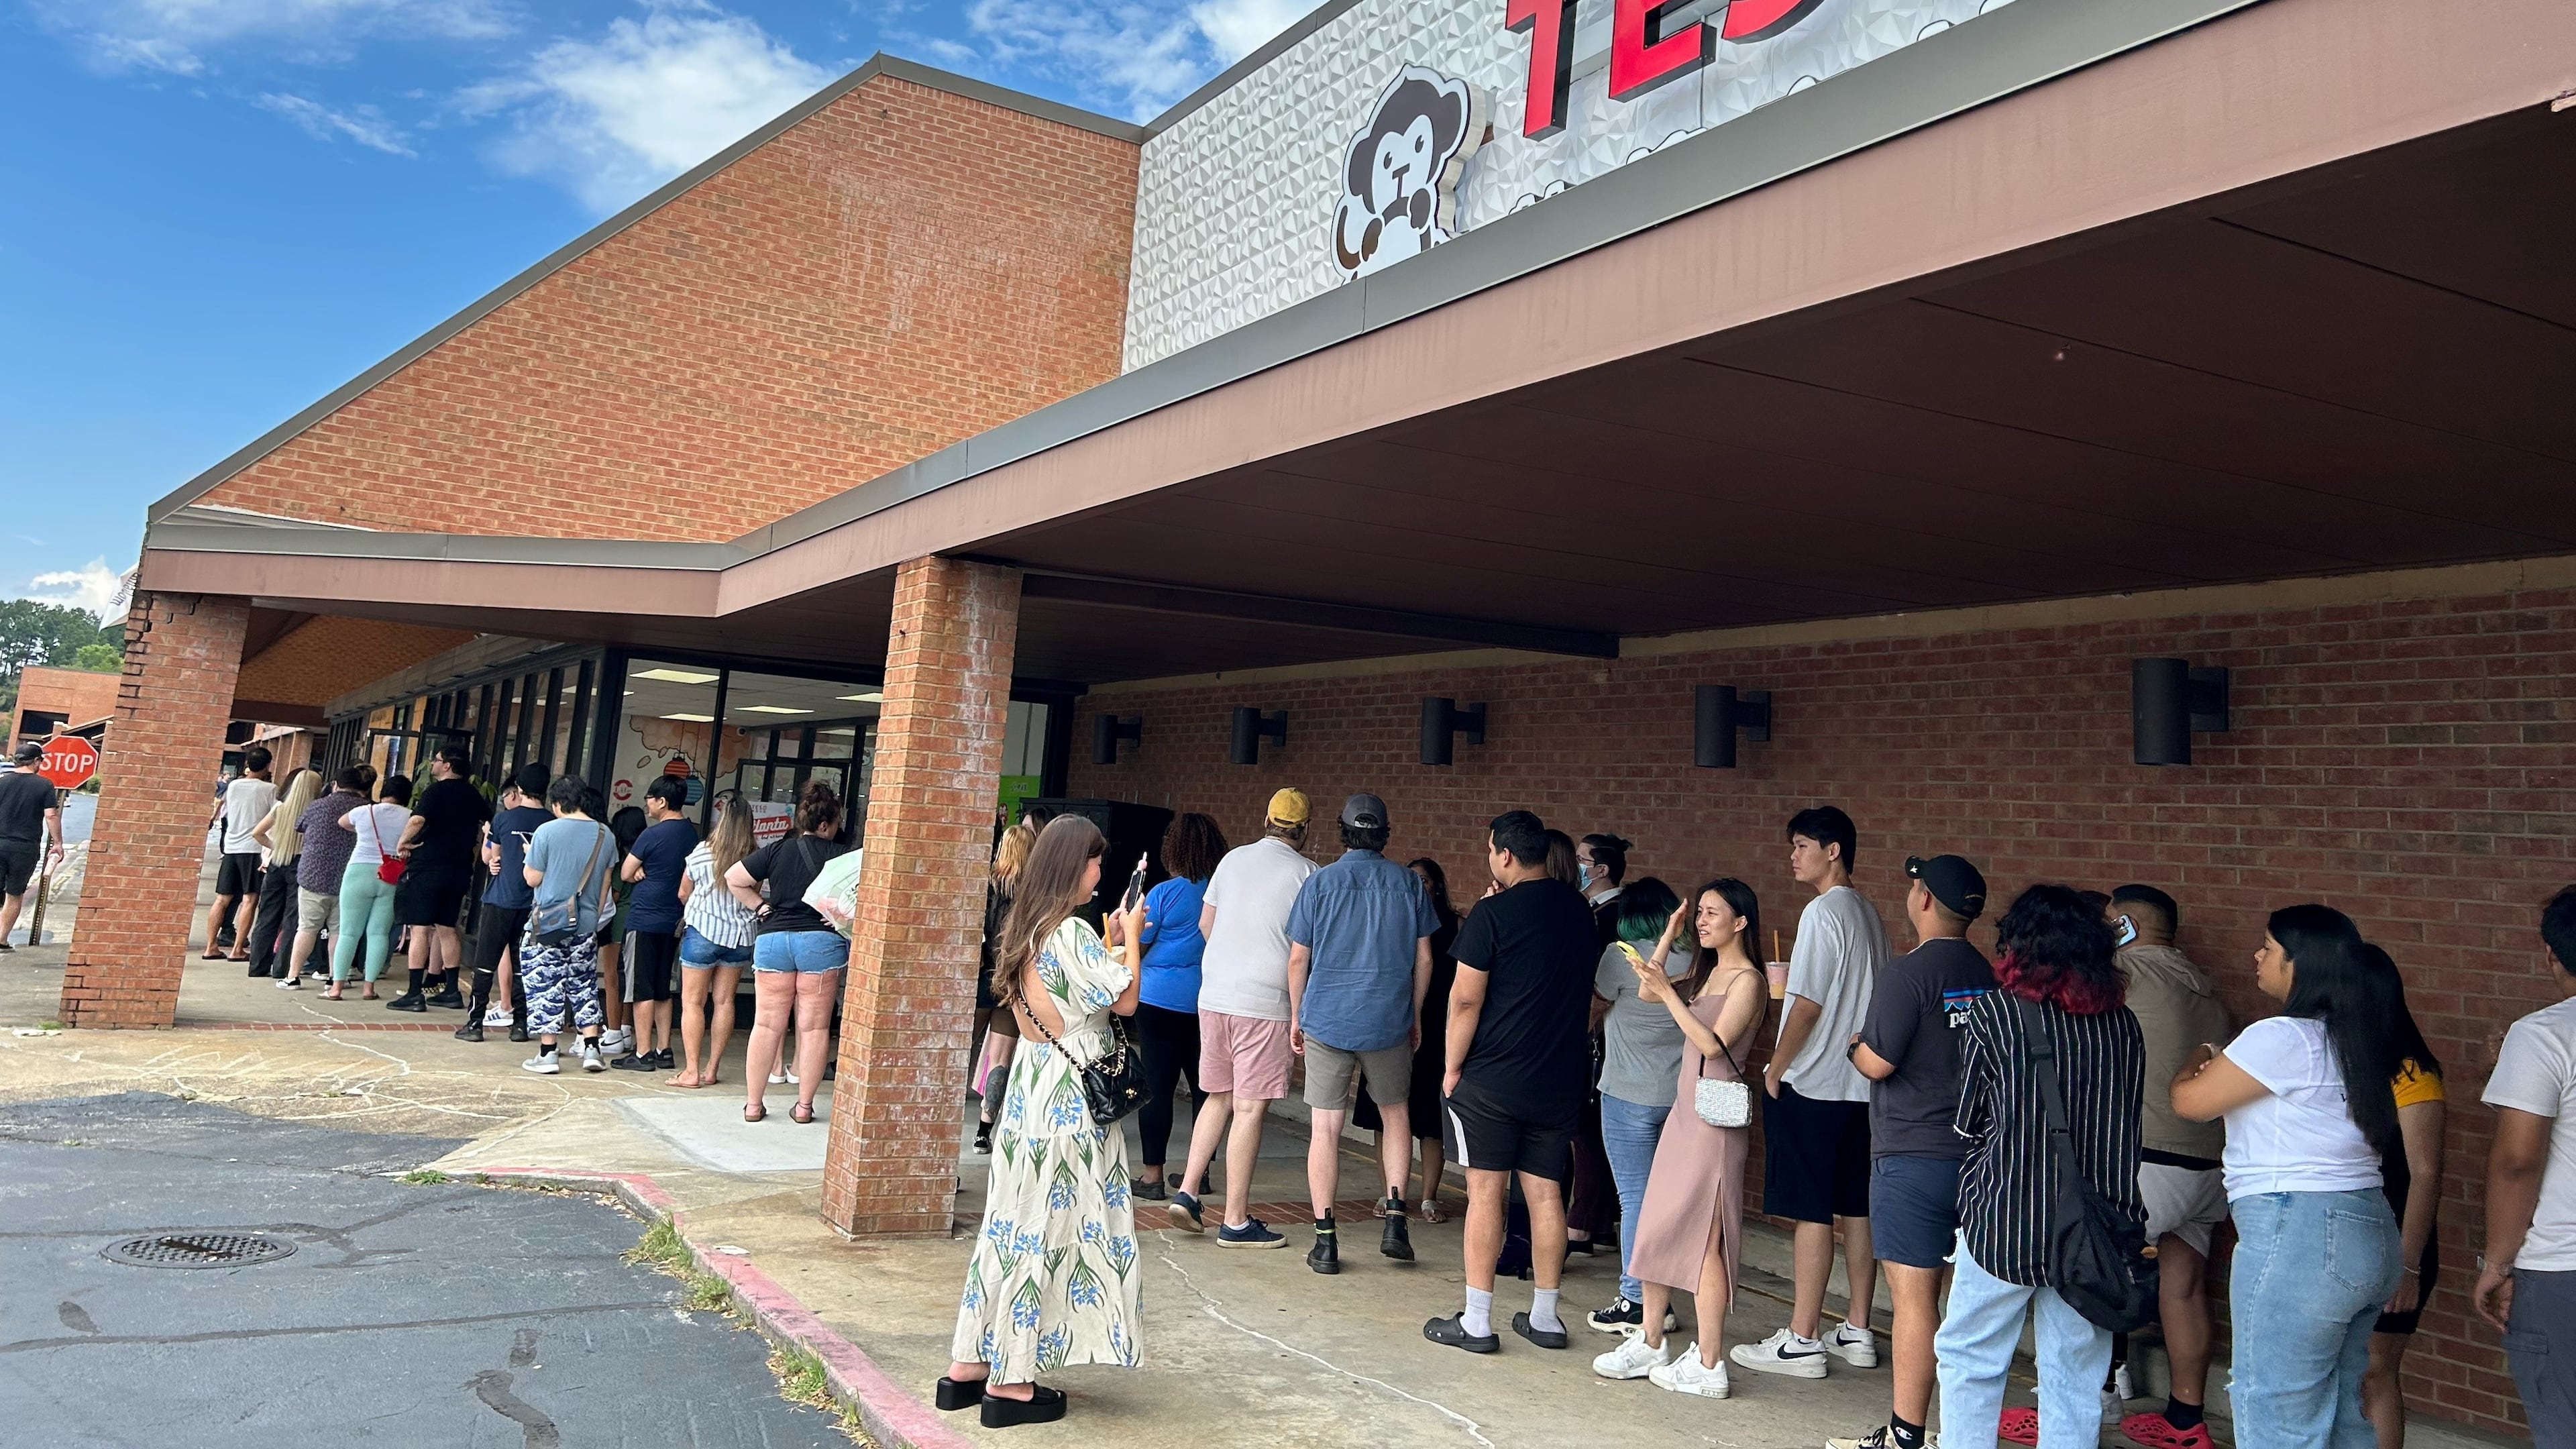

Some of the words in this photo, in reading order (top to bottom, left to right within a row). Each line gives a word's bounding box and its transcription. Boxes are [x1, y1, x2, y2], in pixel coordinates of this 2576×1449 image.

[1505, 0, 1825, 141] TE
[40, 752, 94, 773] STOP
[1949, 1011, 1969, 1028] pa
